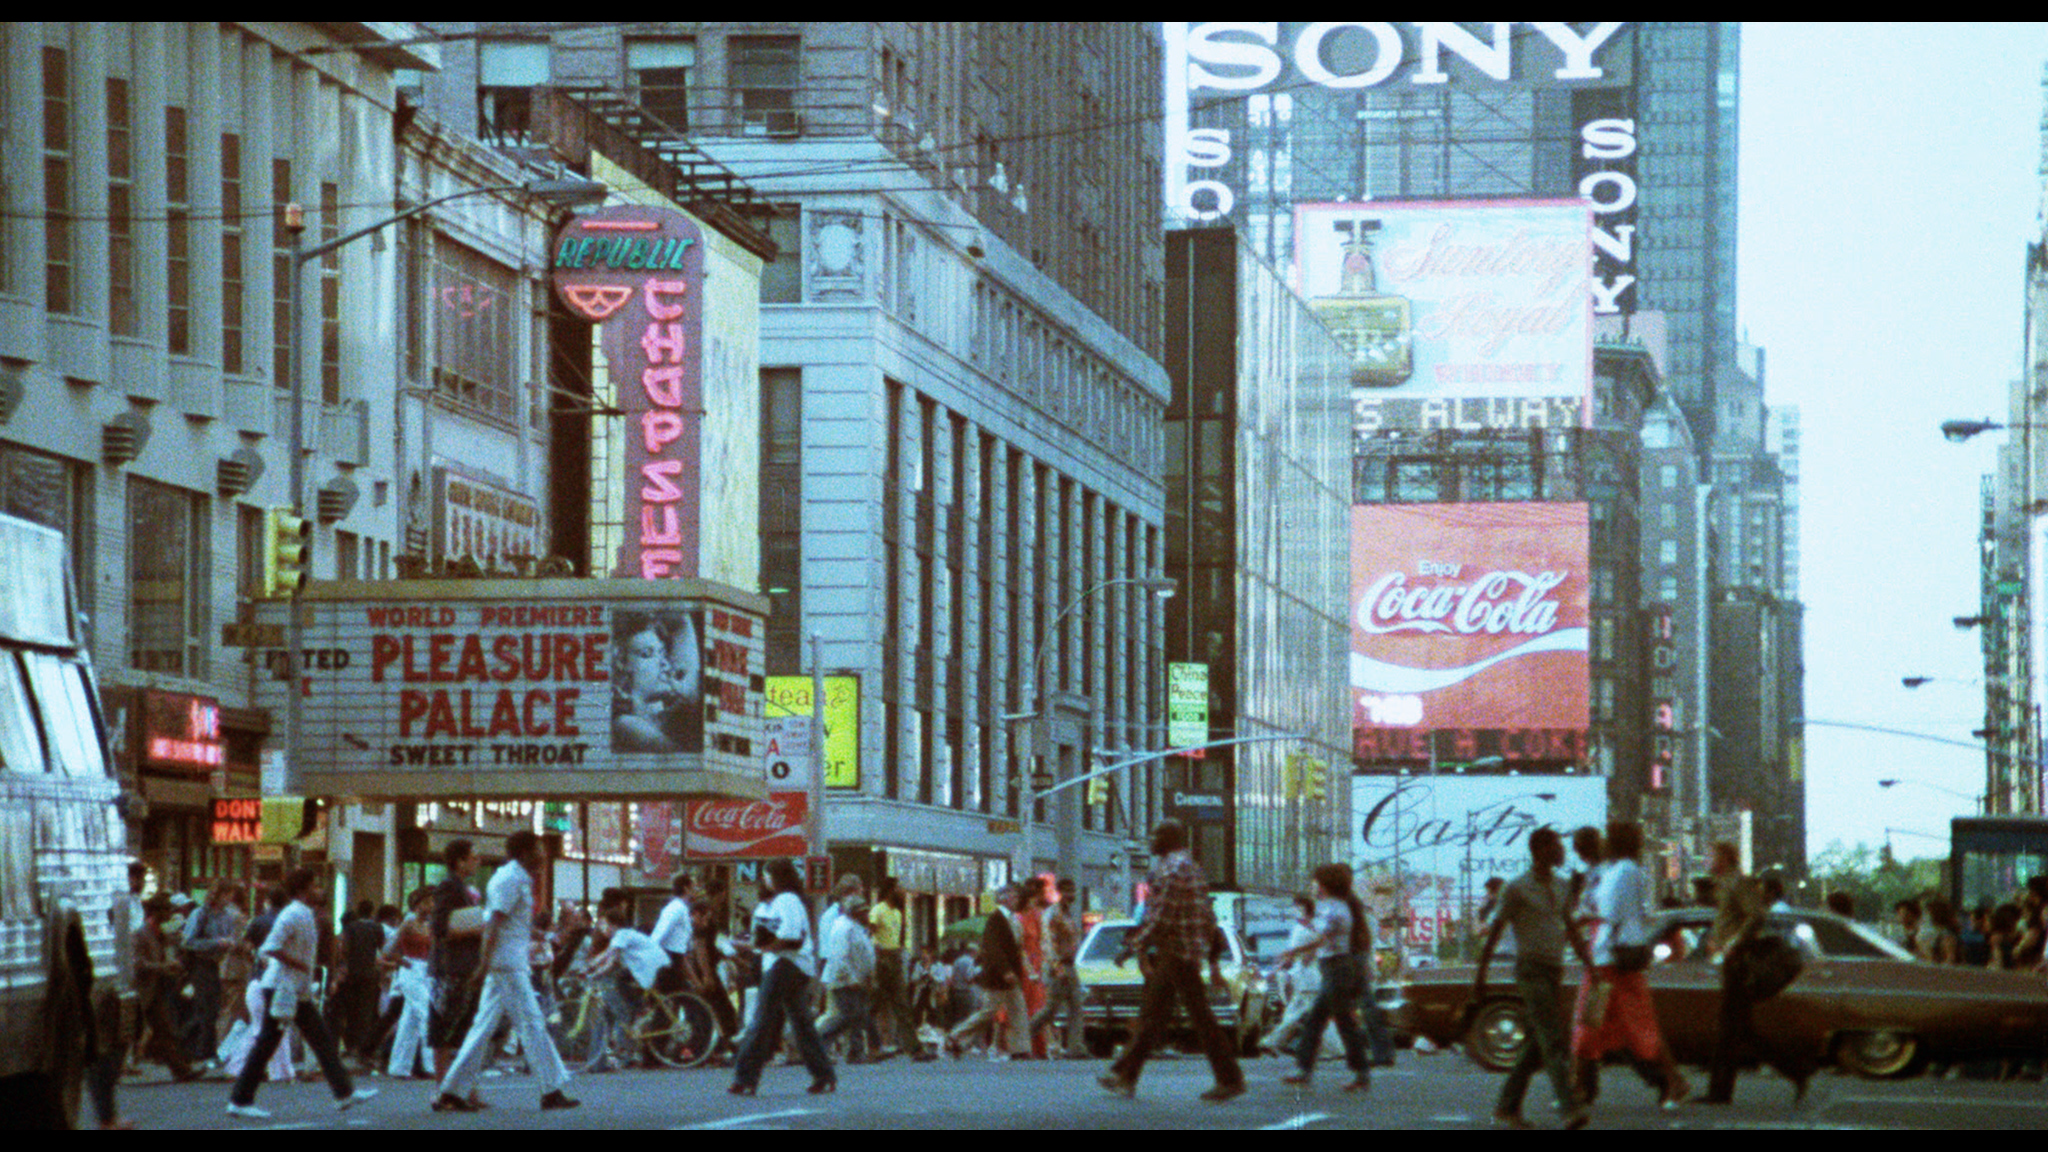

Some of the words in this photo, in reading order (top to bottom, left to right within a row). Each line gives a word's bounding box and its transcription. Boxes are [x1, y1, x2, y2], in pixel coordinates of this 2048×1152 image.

[1186, 22, 1630, 91] SONY
[1185, 128, 1234, 221] SO
[1579, 117, 1637, 315] SONY
[555, 237, 694, 269] REPUBLIC
[1421, 397, 1583, 430] ALWAY
[641, 460, 683, 580] SUE
[1418, 560, 1463, 578] Enjoy
[367, 607, 456, 627] WORLD
[481, 606, 604, 627] PREMIERE
[1357, 571, 1568, 634] Coca-Cola
[371, 634, 609, 682] PLEASURE
[400, 689, 580, 738] PALACE
[390, 745, 473, 765] SWEET
[491, 744, 588, 764] THROAT
[1357, 728, 1431, 759] AVE
[693, 800, 787, 829] Coca-Cola
